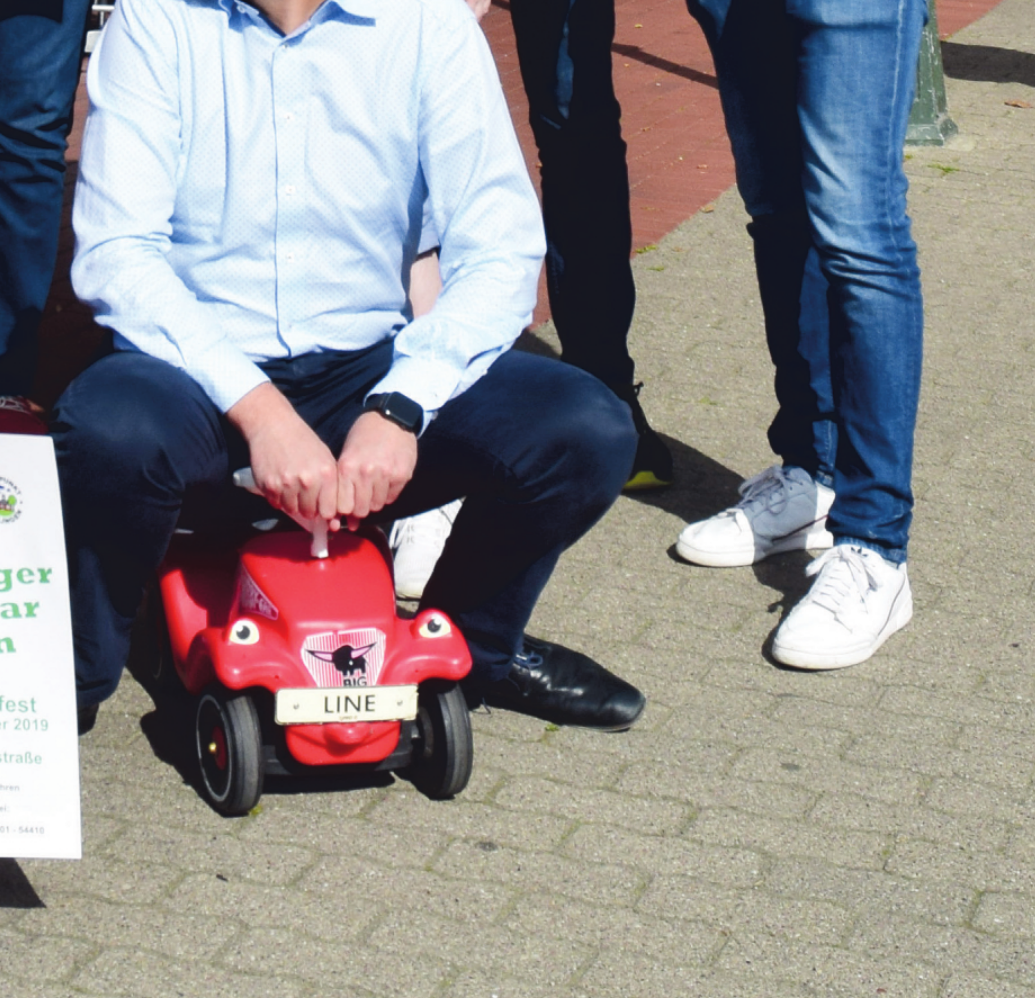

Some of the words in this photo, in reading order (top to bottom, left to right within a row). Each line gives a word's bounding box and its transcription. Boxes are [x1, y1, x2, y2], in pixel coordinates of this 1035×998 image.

[343, 677, 367, 687] BIG
[324, 695, 375, 714] LINE
[13, 718, 49, 731] 2019
